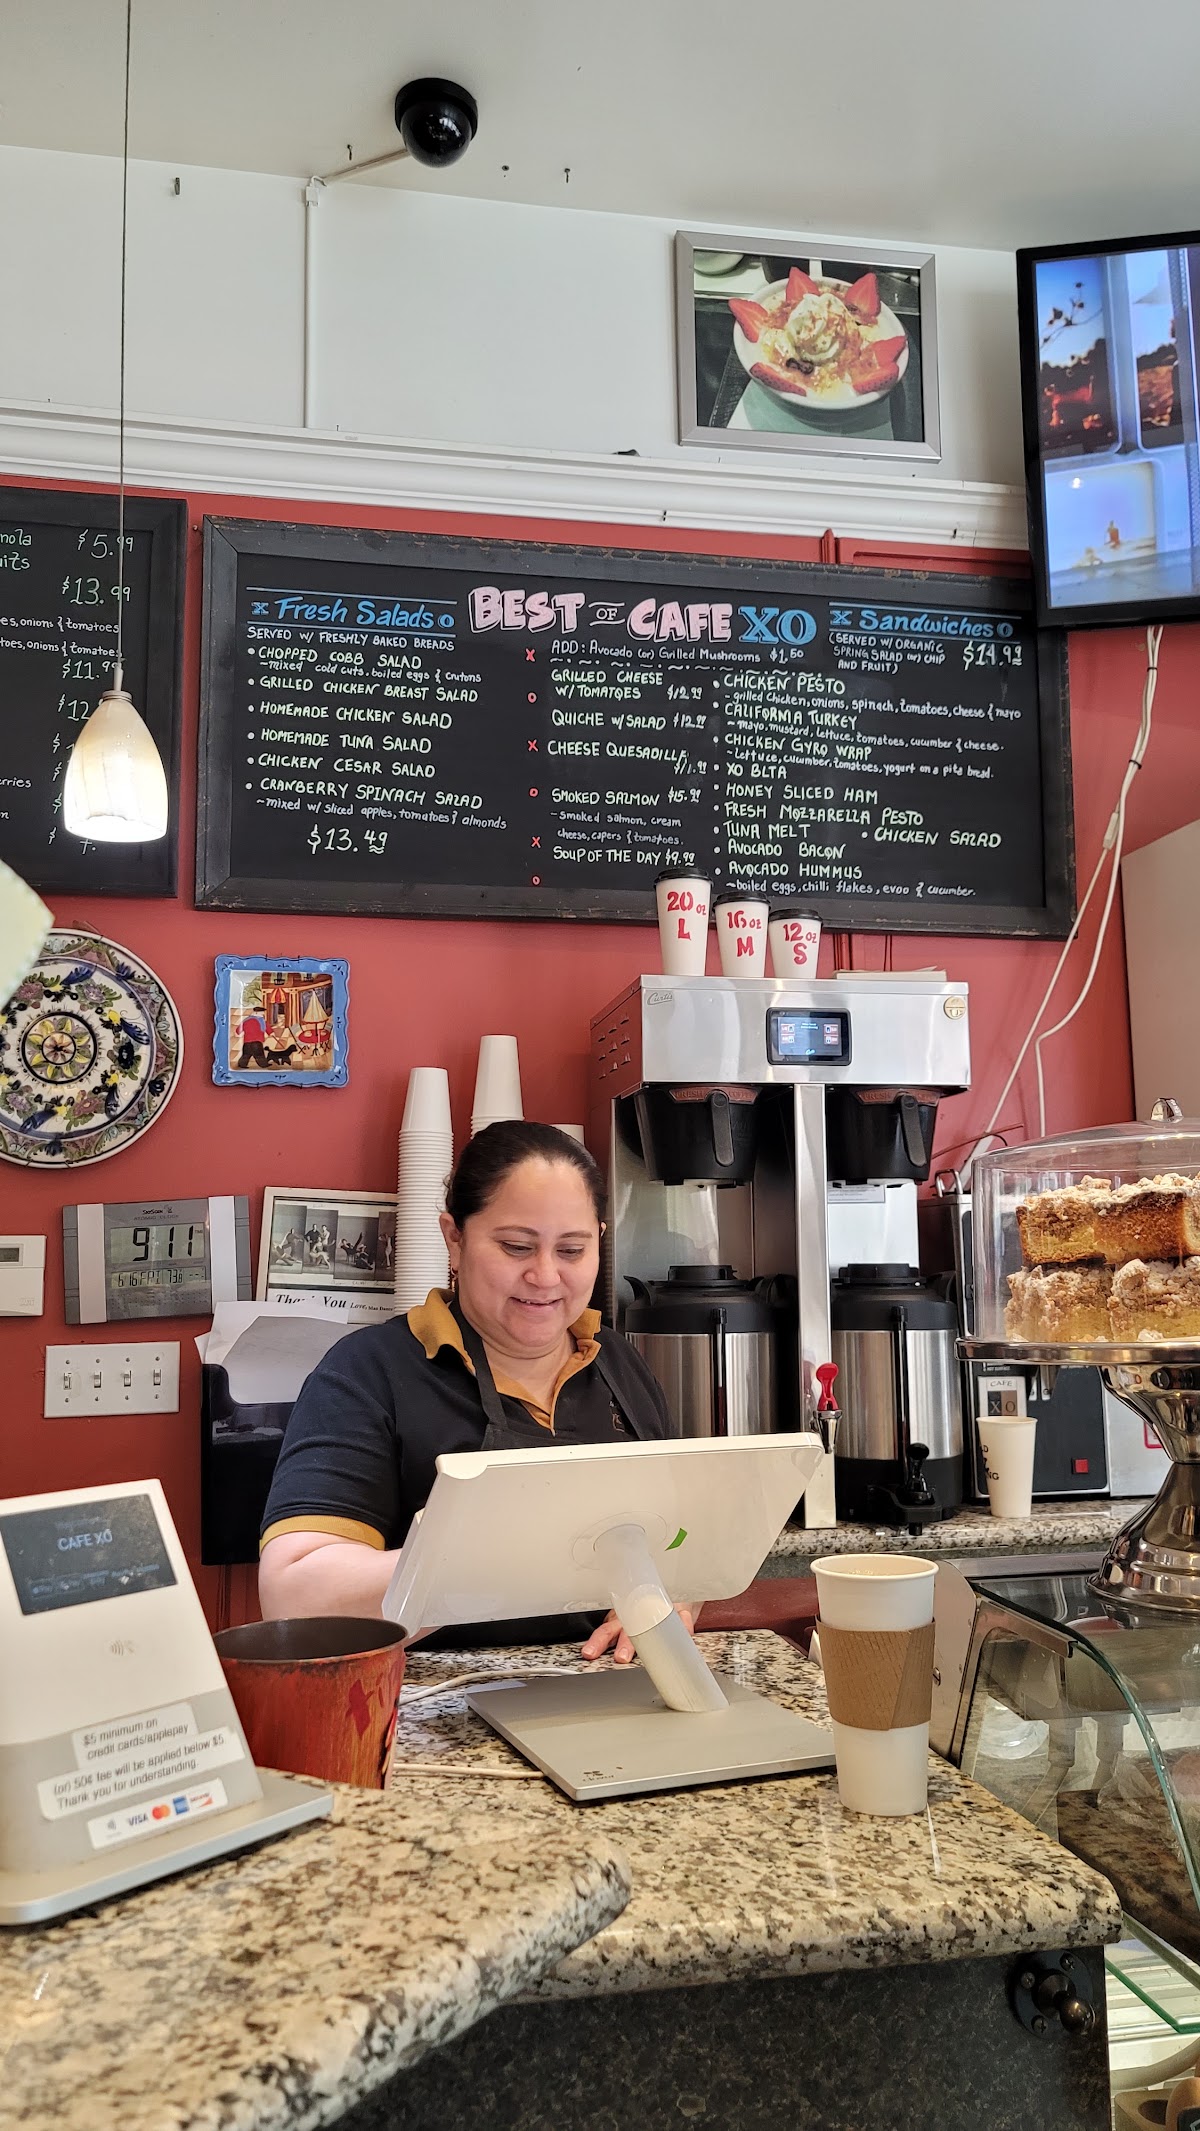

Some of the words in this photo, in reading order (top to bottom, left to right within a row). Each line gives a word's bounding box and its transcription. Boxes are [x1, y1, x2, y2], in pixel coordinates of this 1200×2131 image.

[275, 596, 348, 622] Fresh
[356, 600, 434, 628] Salads
[468, 586, 585, 634] BEST
[596, 609, 618, 621] OF
[627, 598, 732, 643] CAFE
[738, 606, 817, 645] XO
[859, 609, 994, 637] Sandwiches
[247, 627, 291, 640] SERVED
[319, 632, 368, 646] FRESHLY
[373, 635, 407, 648] BAKED
[414, 638, 454, 650] BREADS
[829, 632, 876, 646] (SERVED
[895, 639, 944, 653] ORGANIC
[258, 646, 317, 662] CHOPPED
[330, 651, 363, 665] COBB
[377, 654, 422, 669] SALAD
[590, 641, 633, 658] Avocado
[659, 648, 695, 660] Grilled
[699, 649, 761, 663] Mushrooms
[833, 645, 869, 660] SPRING
[871, 647, 903, 662] SALAD
[924, 654, 945, 664] CHIP
[315, 663, 337, 673] cold
[407, 671, 430, 683] eggs
[551, 669, 606, 683] GRILLED
[617, 670, 663, 685] CHEESE
[838, 660, 857, 670] AND
[861, 660, 898, 674] FRUIT)
[260, 676, 313, 690] GRILLED
[324, 681, 379, 695] CHICKEN
[384, 685, 429, 699] BREAST
[436, 689, 478, 702] SALAD
[577, 685, 641, 701] TOMATOES
[724, 674, 791, 691] CHICKEN
[797, 676, 845, 695] PESTO
[260, 702, 329, 718] HOMEMADE
[336, 707, 395, 724] CHICKEN
[402, 712, 452, 729] SALAD
[733, 692, 763, 705] grilled
[953, 705, 985, 718] cheese
[996, 708, 1021, 720] mayo
[552, 709, 604, 726] QUICHE
[626, 715, 666, 730] SALAD
[808, 710, 857, 730] TURKEY
[261, 728, 329, 747] HOMEMADE
[340, 734, 374, 749] TUNA
[382, 736, 431, 754] SALAD
[547, 740, 600, 756] CHEESE
[725, 734, 786, 751] CHICKEN
[791, 738, 828, 757] GYRO
[836, 745, 872, 761] WRAP
[910, 737, 952, 749] cucumber
[258, 753, 323, 770] CHICKEN
[333, 758, 382, 774] CESAR
[392, 762, 435, 777] SALAD
[726, 762, 743, 777] XO
[751, 763, 787, 780] BLTA
[883, 763, 915, 776] yogurt
[920, 765, 930, 773] on
[932, 766, 938, 774] a
[943, 764, 963, 777] pita
[260, 778, 349, 798] CRANBERRY
[355, 785, 426, 805] SPINACH
[435, 791, 482, 809] SALAD
[552, 788, 600, 804] SMOKED
[605, 791, 660, 806] SALMON
[726, 782, 773, 799] HONEY
[783, 784, 834, 800] SLICED
[844, 787, 878, 805] HAM
[400, 809, 450, 823] tomatoes
[462, 815, 507, 829] almonds
[651, 816, 682, 827] cream
[724, 801, 767, 818] FRESH
[779, 803, 871, 825] MOZZARELLA
[882, 807, 923, 826] PESTO
[307, 824, 388, 854] $13.49
[723, 820, 760, 839] TUNA
[768, 824, 811, 842] MELT
[874, 827, 939, 845] CHICKEN
[950, 830, 1001, 848] SALAD
[587, 849, 602, 862] OF
[606, 850, 631, 863] THE
[637, 851, 661, 865] DAY
[728, 839, 782, 856] AVOCADO
[799, 842, 846, 860] BACON
[729, 861, 789, 877] AVOCADO
[800, 863, 862, 879] HUMMUS
[802, 882, 830, 891] chilli
[883, 885, 909, 894] evoo
[667, 891, 694, 911] 20
[678, 918, 691, 940] L
[727, 910, 746, 928] 16
[783, 922, 803, 942] 12
[736, 936, 754, 957] M
[793, 943, 807, 965] S
[323, 1296, 346, 1308] You
[58, 1534, 92, 1550] CAFE
[95, 1529, 113, 1543] XO
[83, 1732, 97, 1747] $5
[100, 1722, 143, 1742] minimum
[146, 1718, 158, 1729] on
[87, 1742, 115, 1760] credit
[117, 1724, 188, 1752] cards/applepay
[54, 1783, 71, 1796] (or)
[96, 1769, 112, 1782] fee
[115, 1762, 131, 1777] will
[133, 1760, 145, 1772] be
[148, 1750, 182, 1769] applied
[184, 1740, 211, 1756] below
[58, 1794, 89, 1809] Thank
[93, 1786, 111, 1801] you
[114, 1779, 127, 1792] for
[130, 1760, 199, 1787] understanding.
[127, 1813, 149, 1826] VISA
